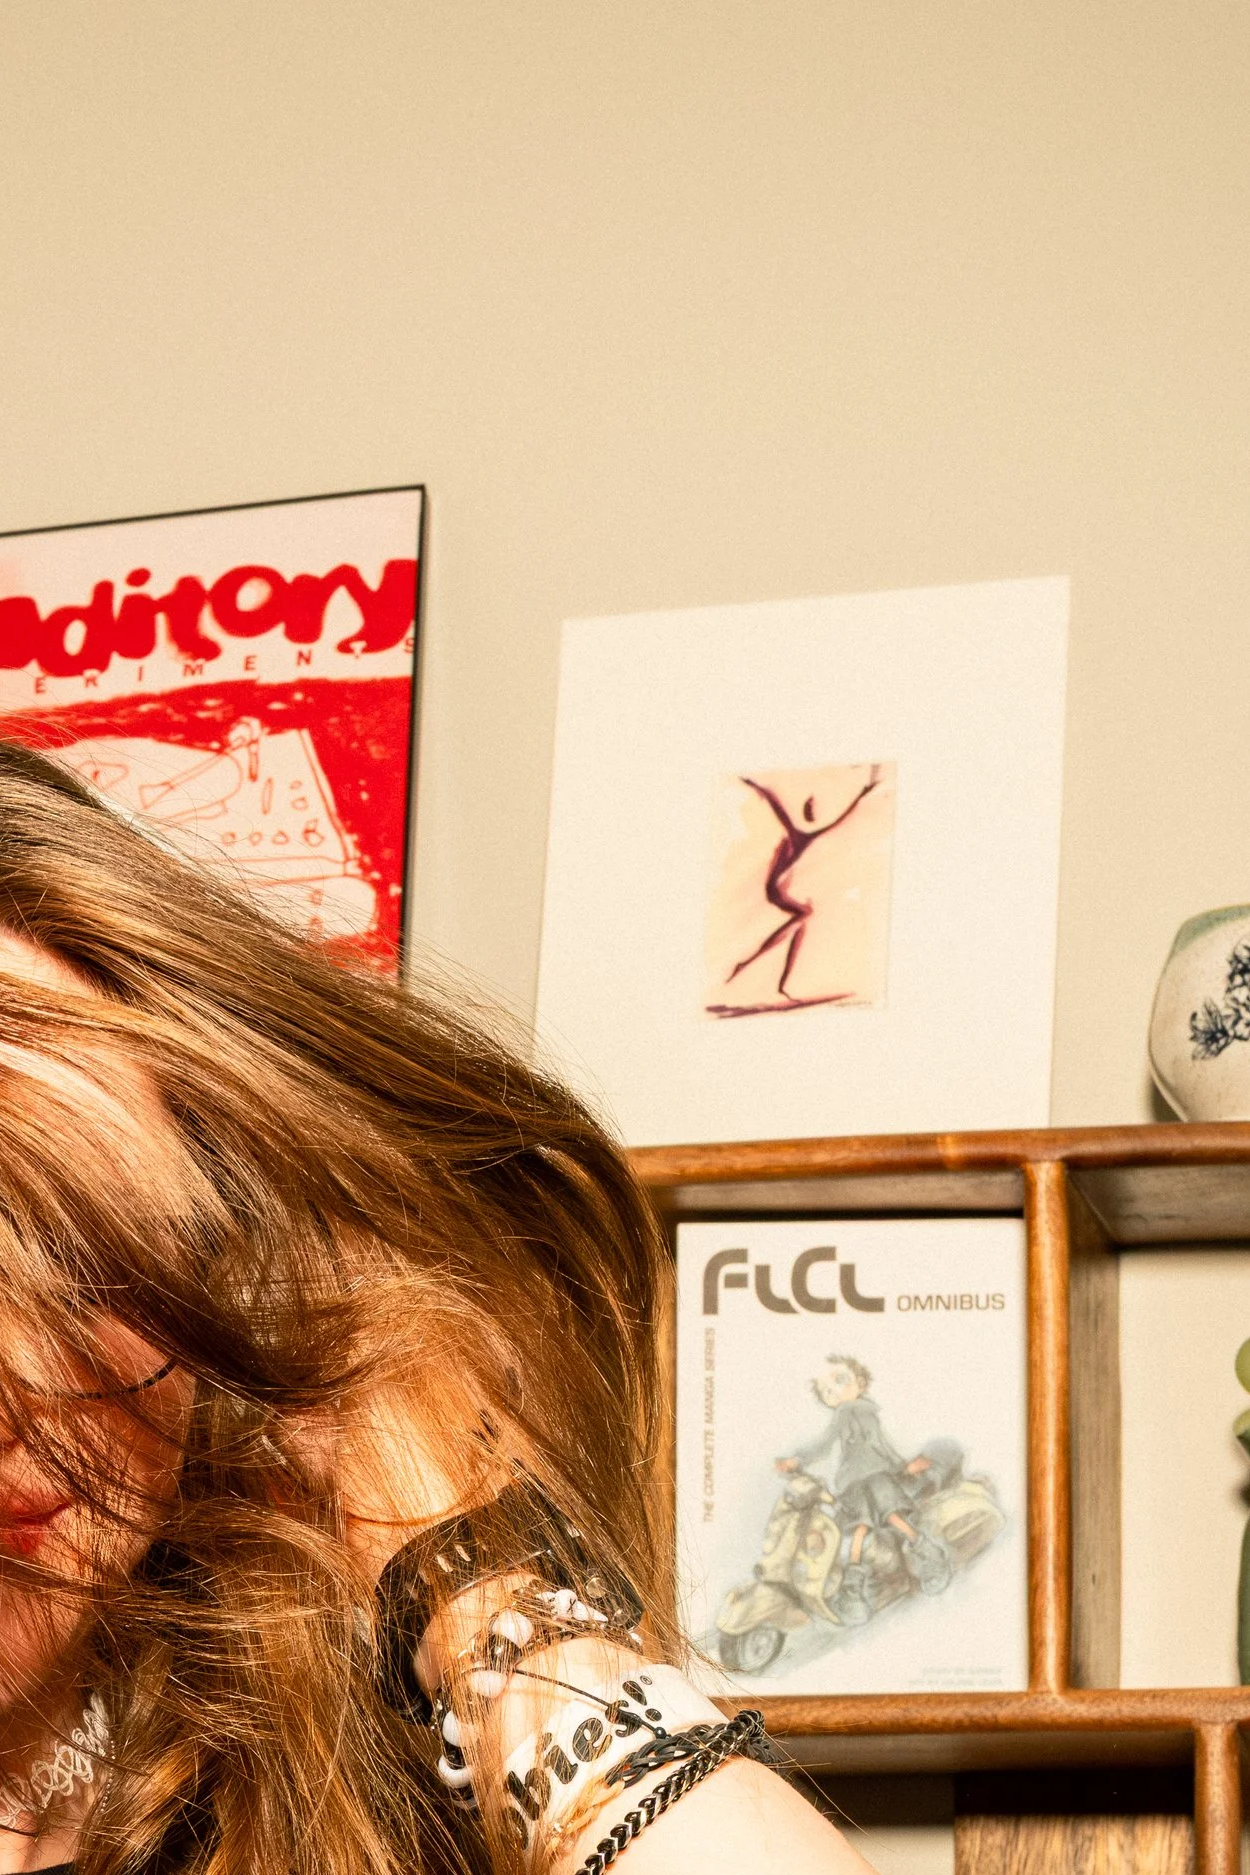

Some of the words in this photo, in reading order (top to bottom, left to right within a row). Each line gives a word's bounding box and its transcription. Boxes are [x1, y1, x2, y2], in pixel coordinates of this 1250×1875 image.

[703, 1246, 885, 1315] FLCL
[897, 1293, 1005, 1312] OMNIBUS
[704, 1327, 715, 1371] SERIES
[704, 1376, 714, 1424] MANGA
[703, 1429, 715, 1496] COMPLETE
